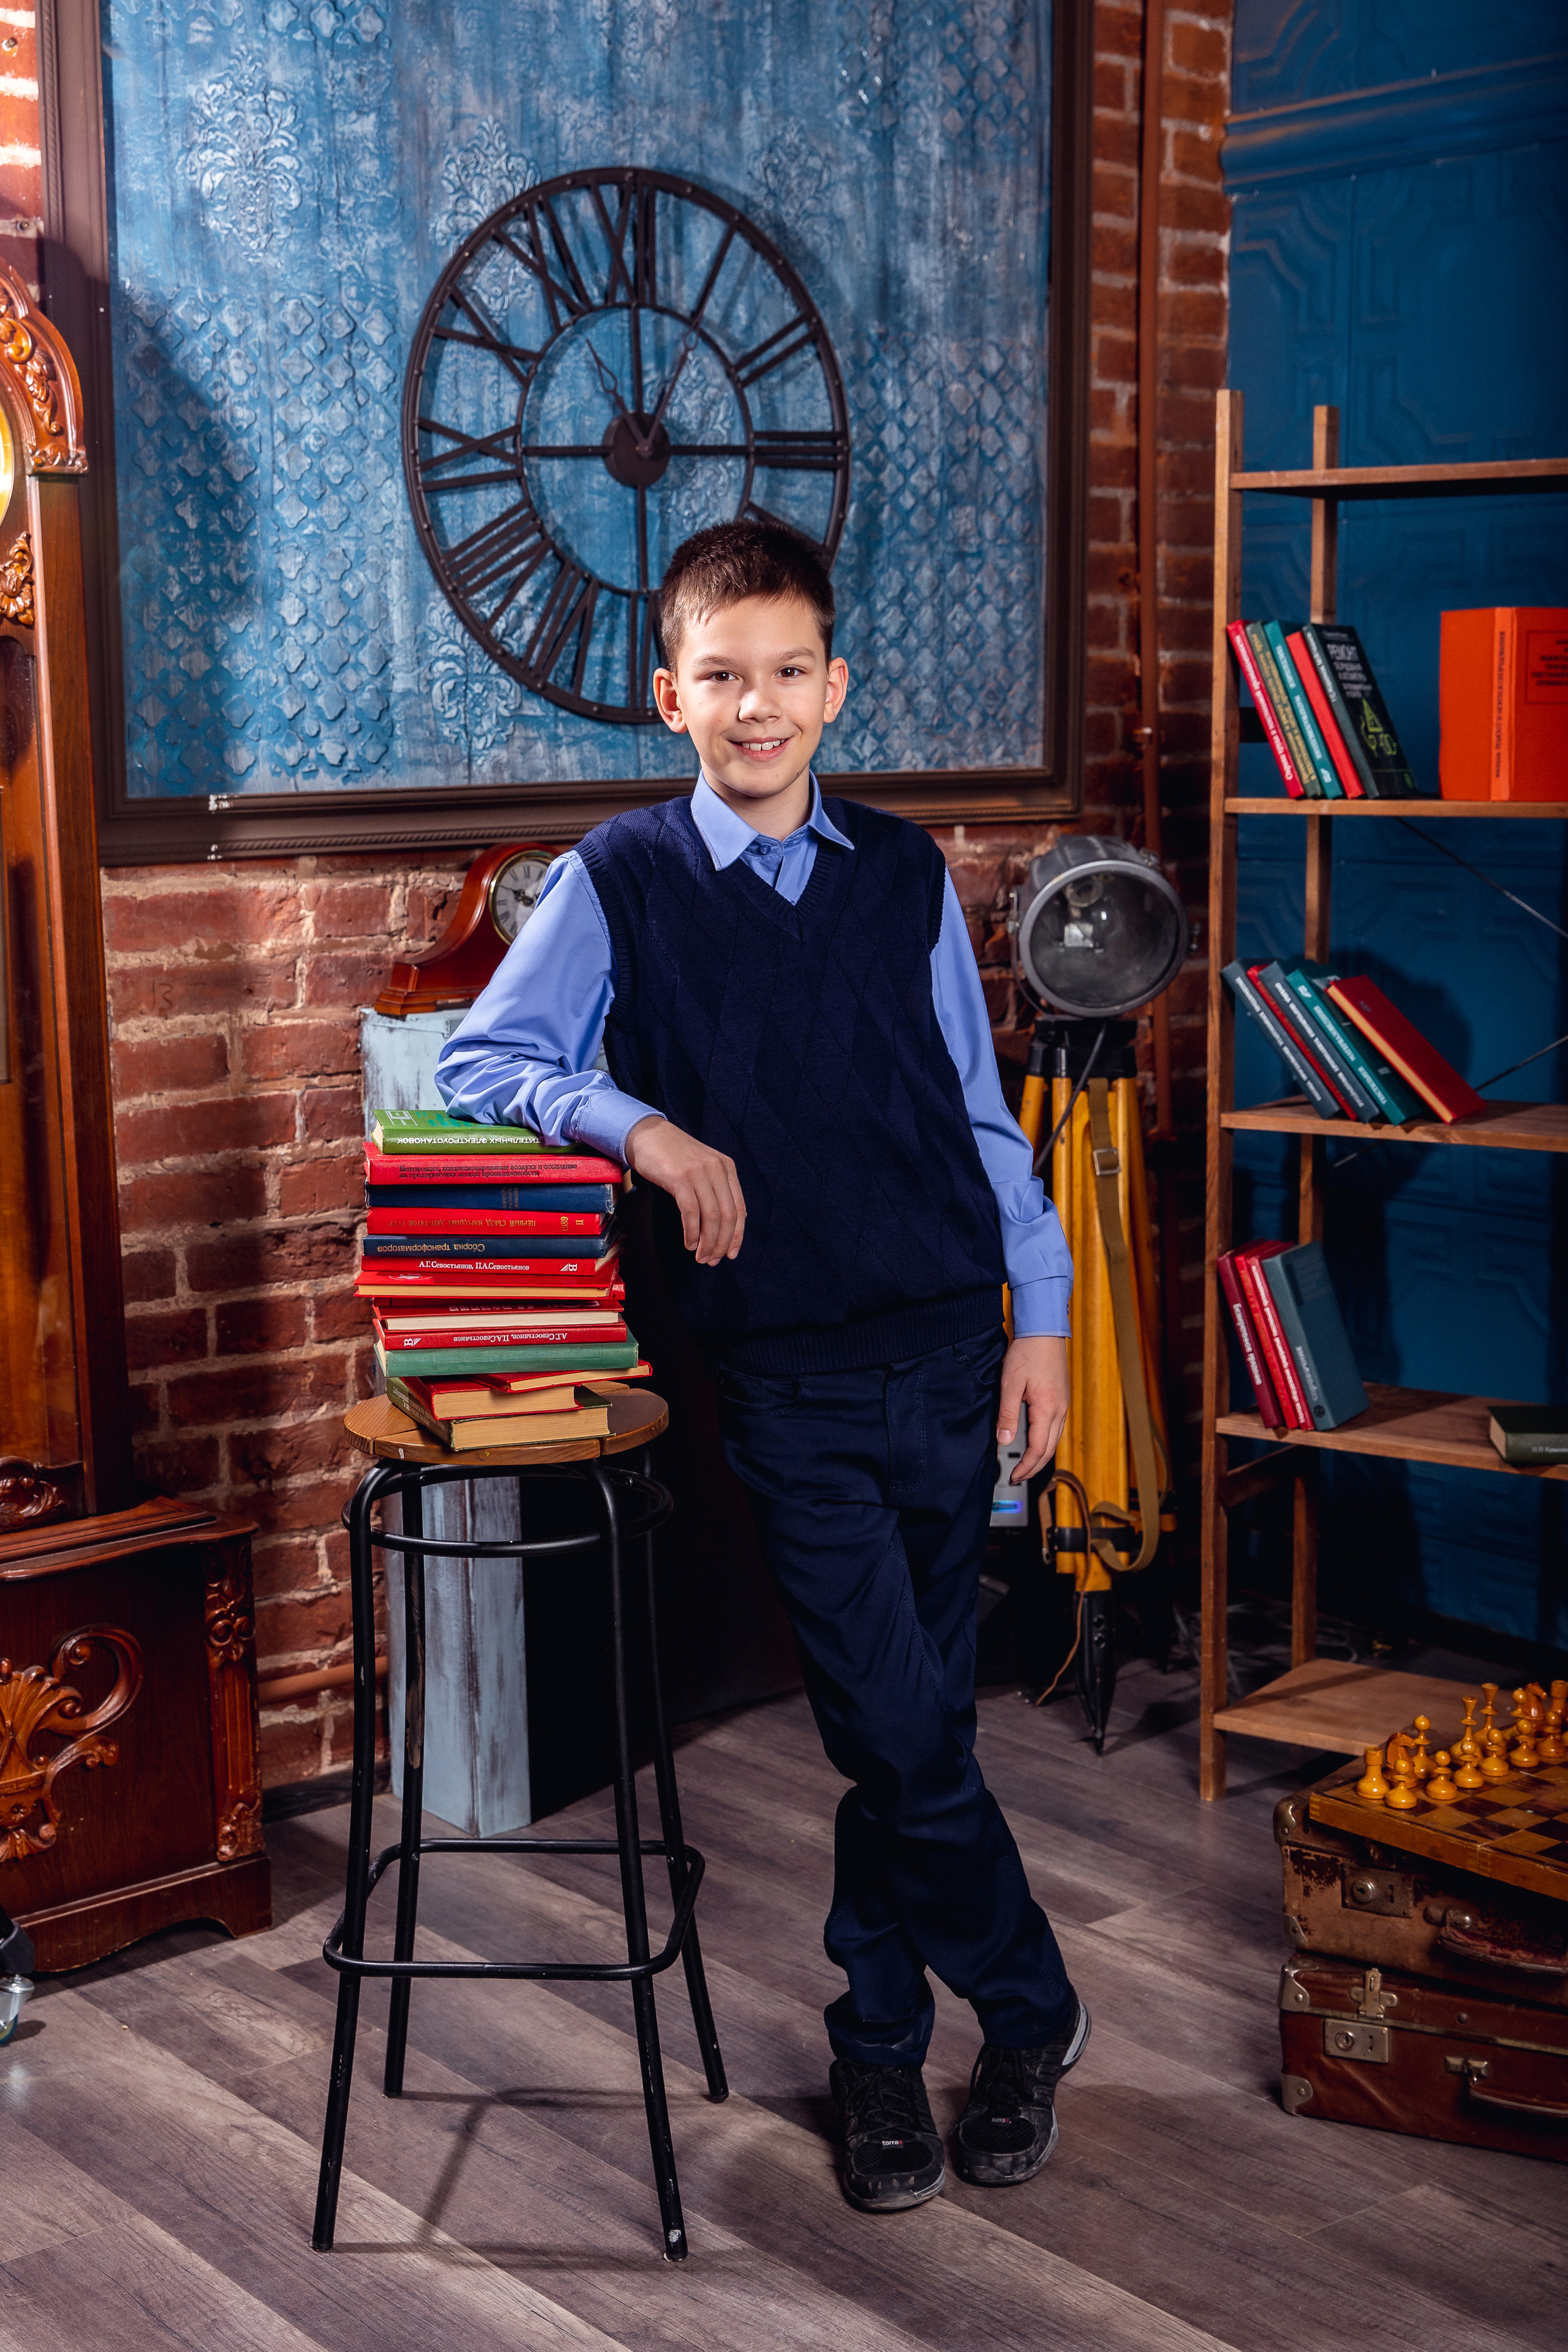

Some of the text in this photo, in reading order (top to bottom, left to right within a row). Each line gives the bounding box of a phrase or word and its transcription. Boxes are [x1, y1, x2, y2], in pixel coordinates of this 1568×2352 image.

[481, 1169, 540, 1178] промышленности
[377, 1243, 485, 1253] Сборка трансформаторов
